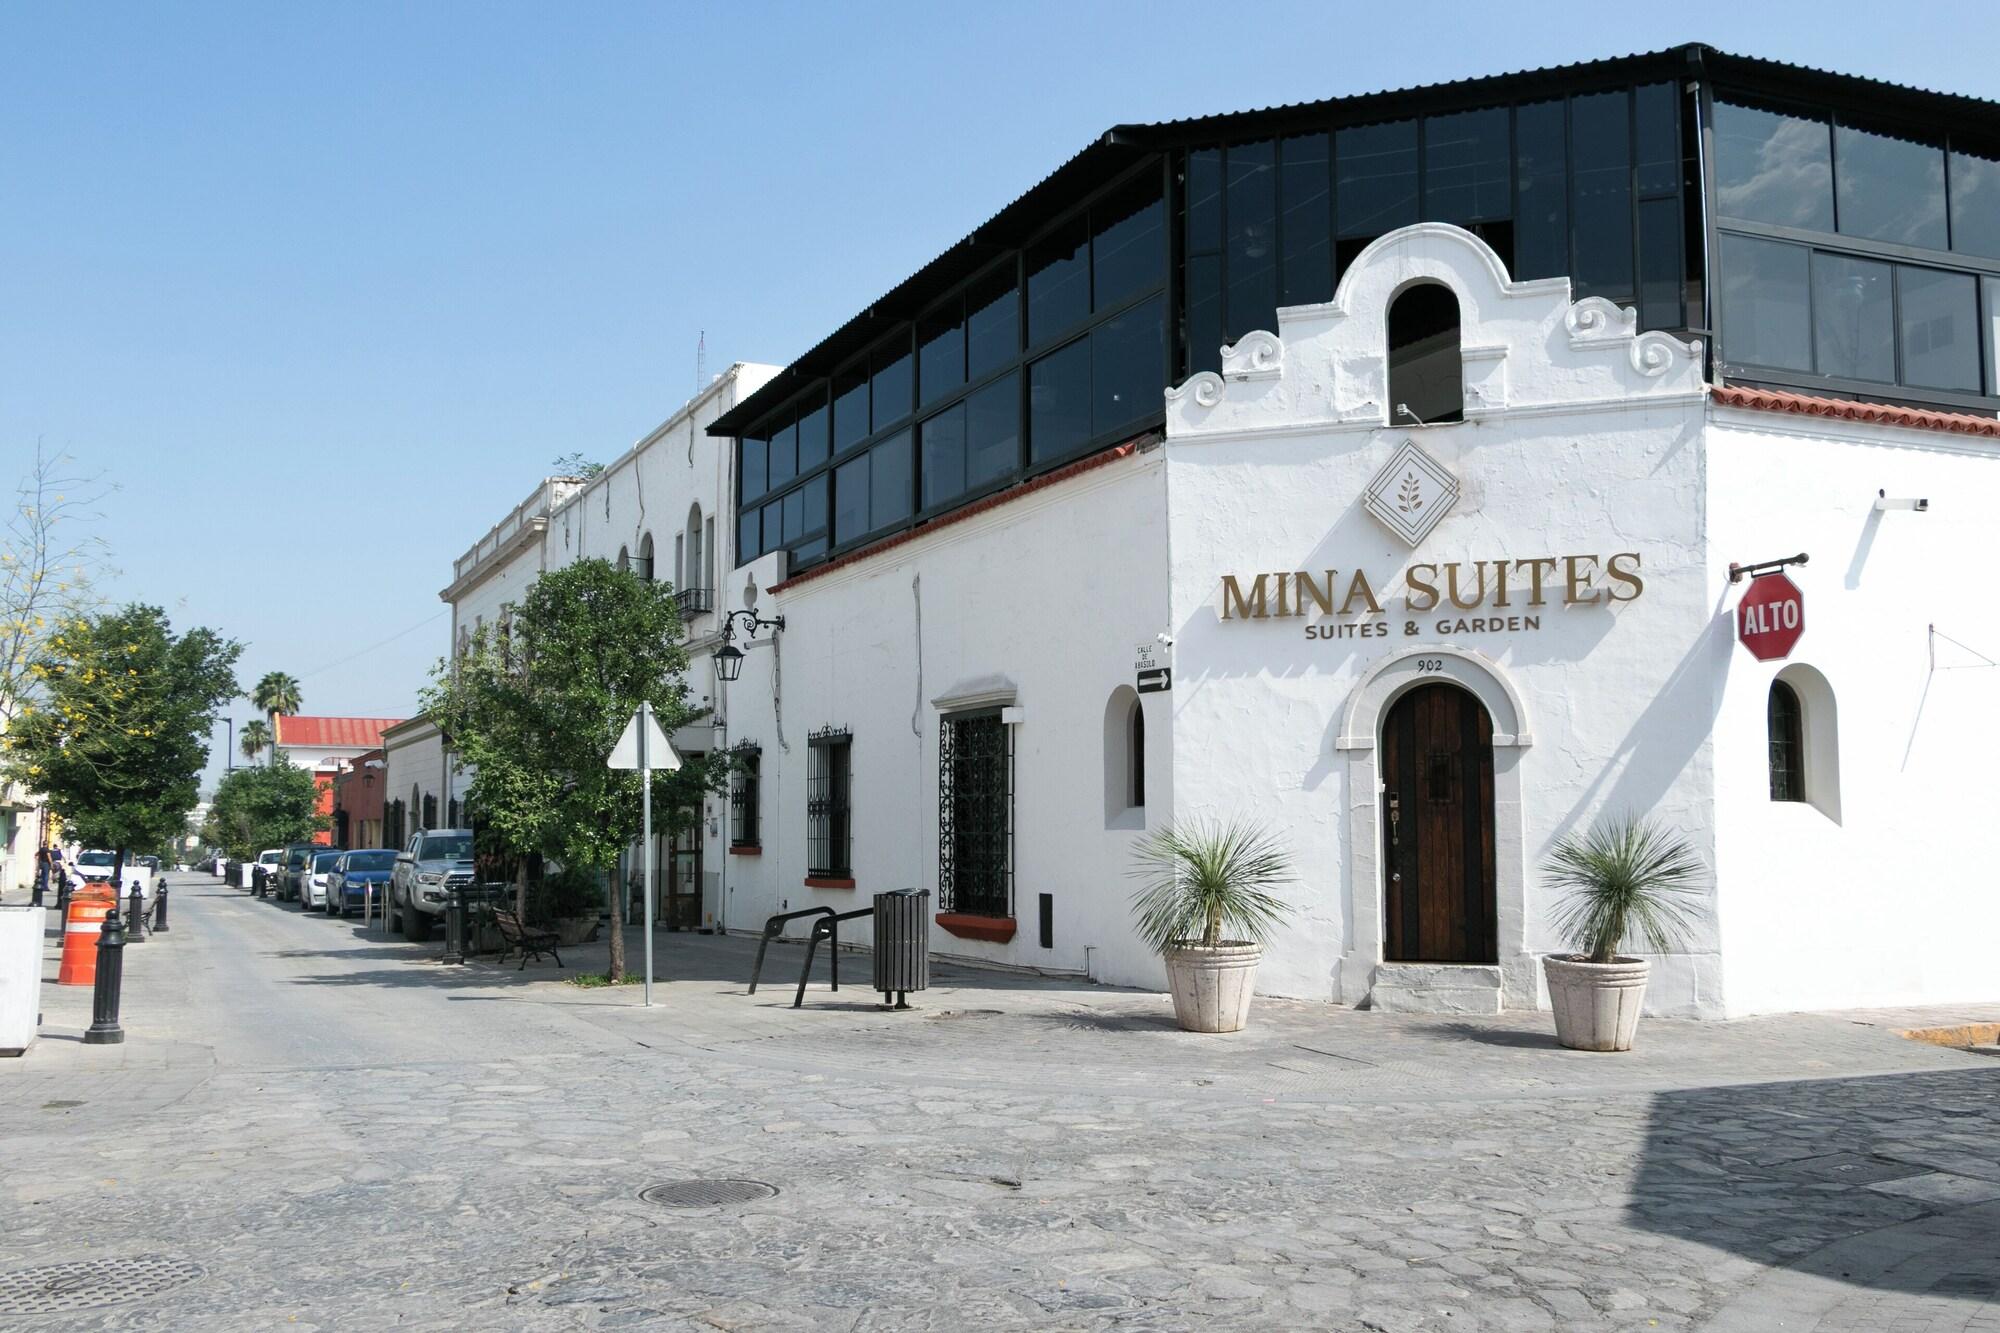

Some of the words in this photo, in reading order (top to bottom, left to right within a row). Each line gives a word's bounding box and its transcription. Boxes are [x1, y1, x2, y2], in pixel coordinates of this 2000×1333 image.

[1220, 568, 1386, 620] MINA
[1405, 552, 1644, 612] SUITES
[1305, 621, 1389, 641] SUITES
[1404, 621, 1421, 637] &
[1436, 615, 1541, 635] GARDEN
[1744, 599, 1799, 635] ALTO
[1137, 645, 1152, 654] CALLE
[1418, 660, 1442, 672] 902
